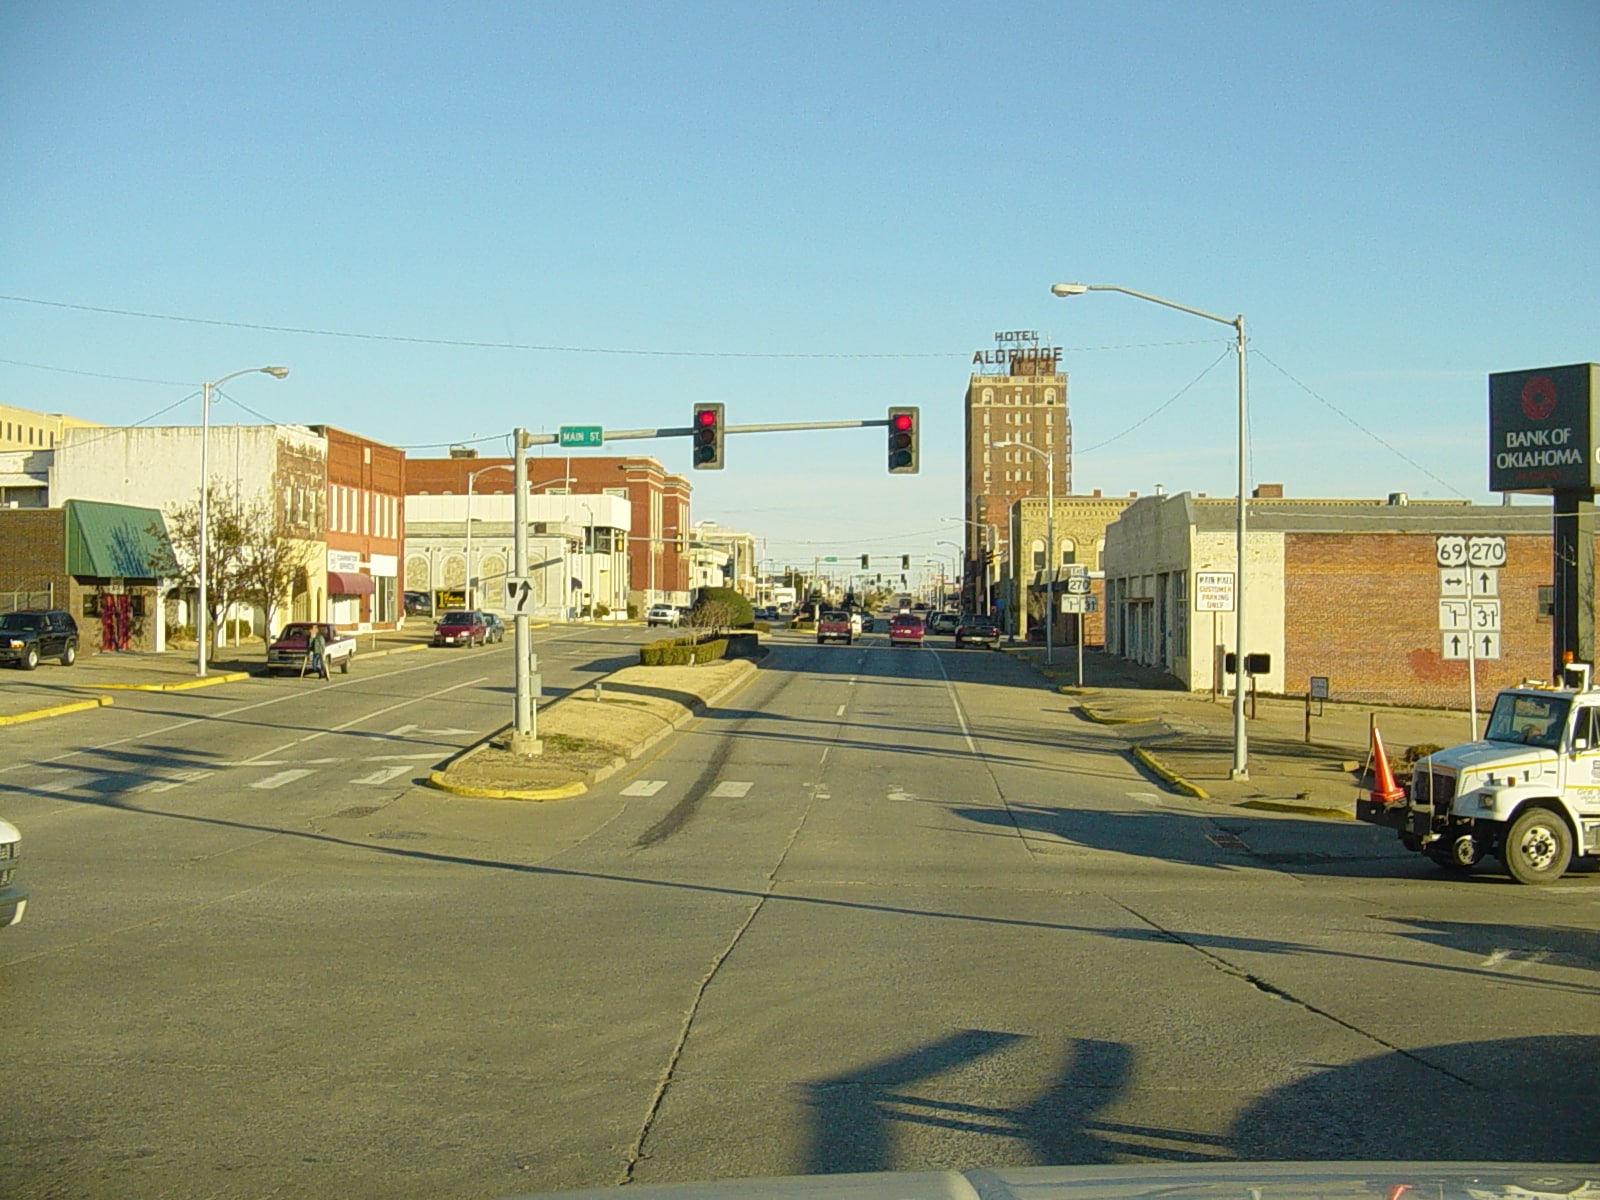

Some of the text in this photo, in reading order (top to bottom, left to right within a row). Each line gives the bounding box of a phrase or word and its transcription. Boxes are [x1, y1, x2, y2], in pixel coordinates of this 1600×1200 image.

[994, 330, 1040, 342] HOTEL
[972, 347, 1063, 365] ALDRIDGE
[563, 431, 585, 442] MAIN
[1506, 427, 1572, 449] BANK OF
[1496, 448, 1583, 470] OKLAHOMA
[1440, 543, 1463, 561] 69
[1471, 543, 1504, 560] 270
[1070, 580, 1090, 591] 270
[1206, 601, 1225, 609] ONLY
[1477, 610, 1496, 628] 31
